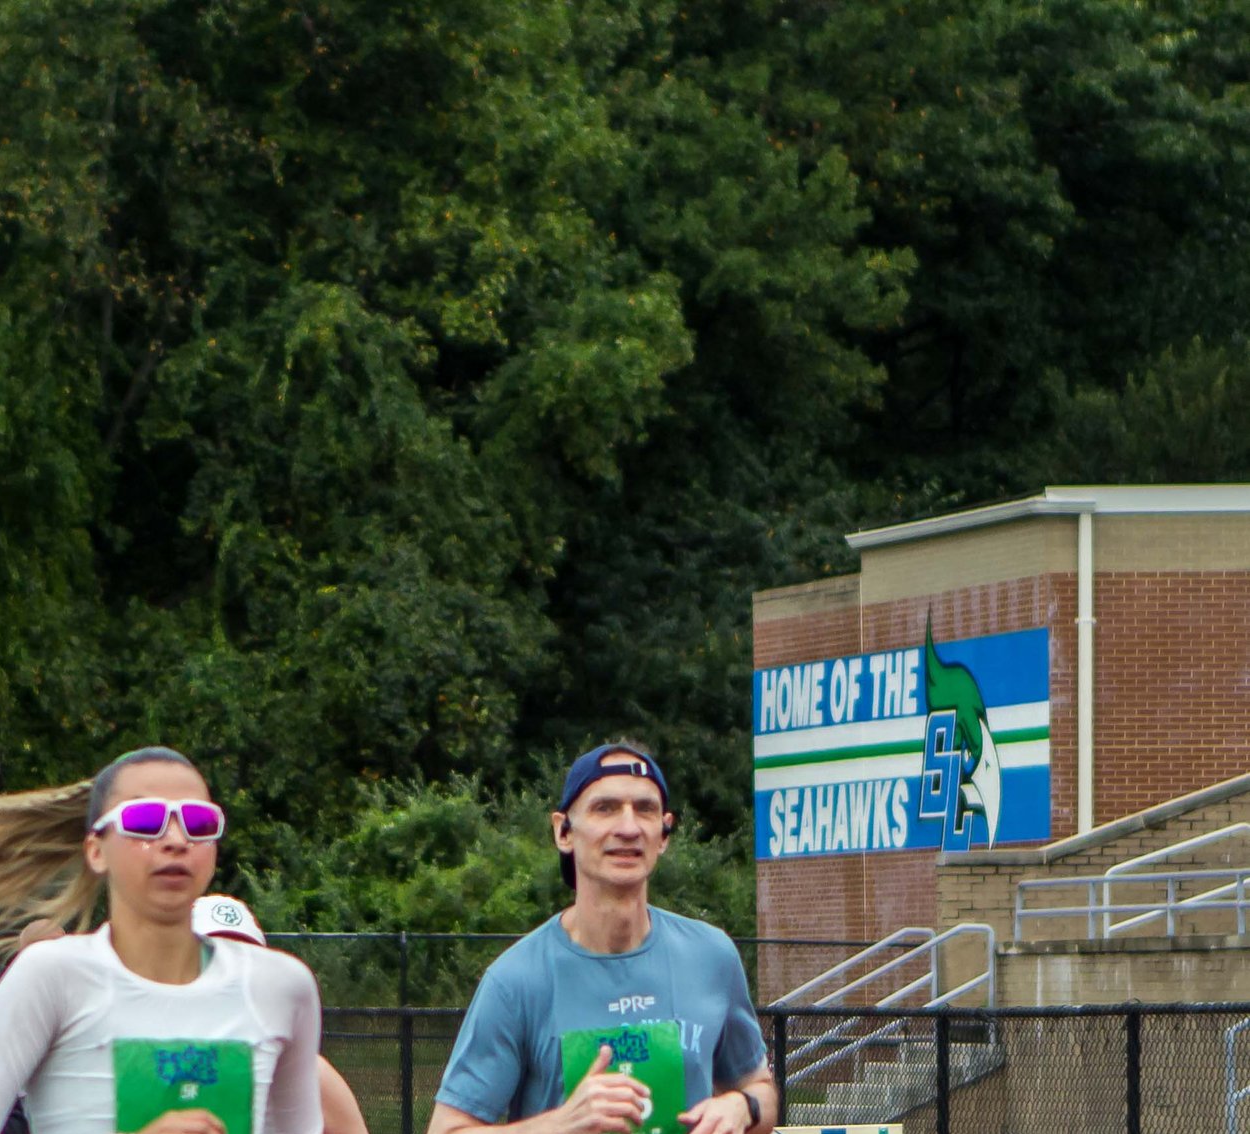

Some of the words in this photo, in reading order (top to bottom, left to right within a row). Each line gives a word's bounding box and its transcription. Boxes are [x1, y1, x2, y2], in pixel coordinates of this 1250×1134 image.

[760, 663, 825, 732] HOME
[829, 657, 862, 723] OF
[869, 648, 919, 719] THE
[769, 778, 909, 857] SEAHAWKS
